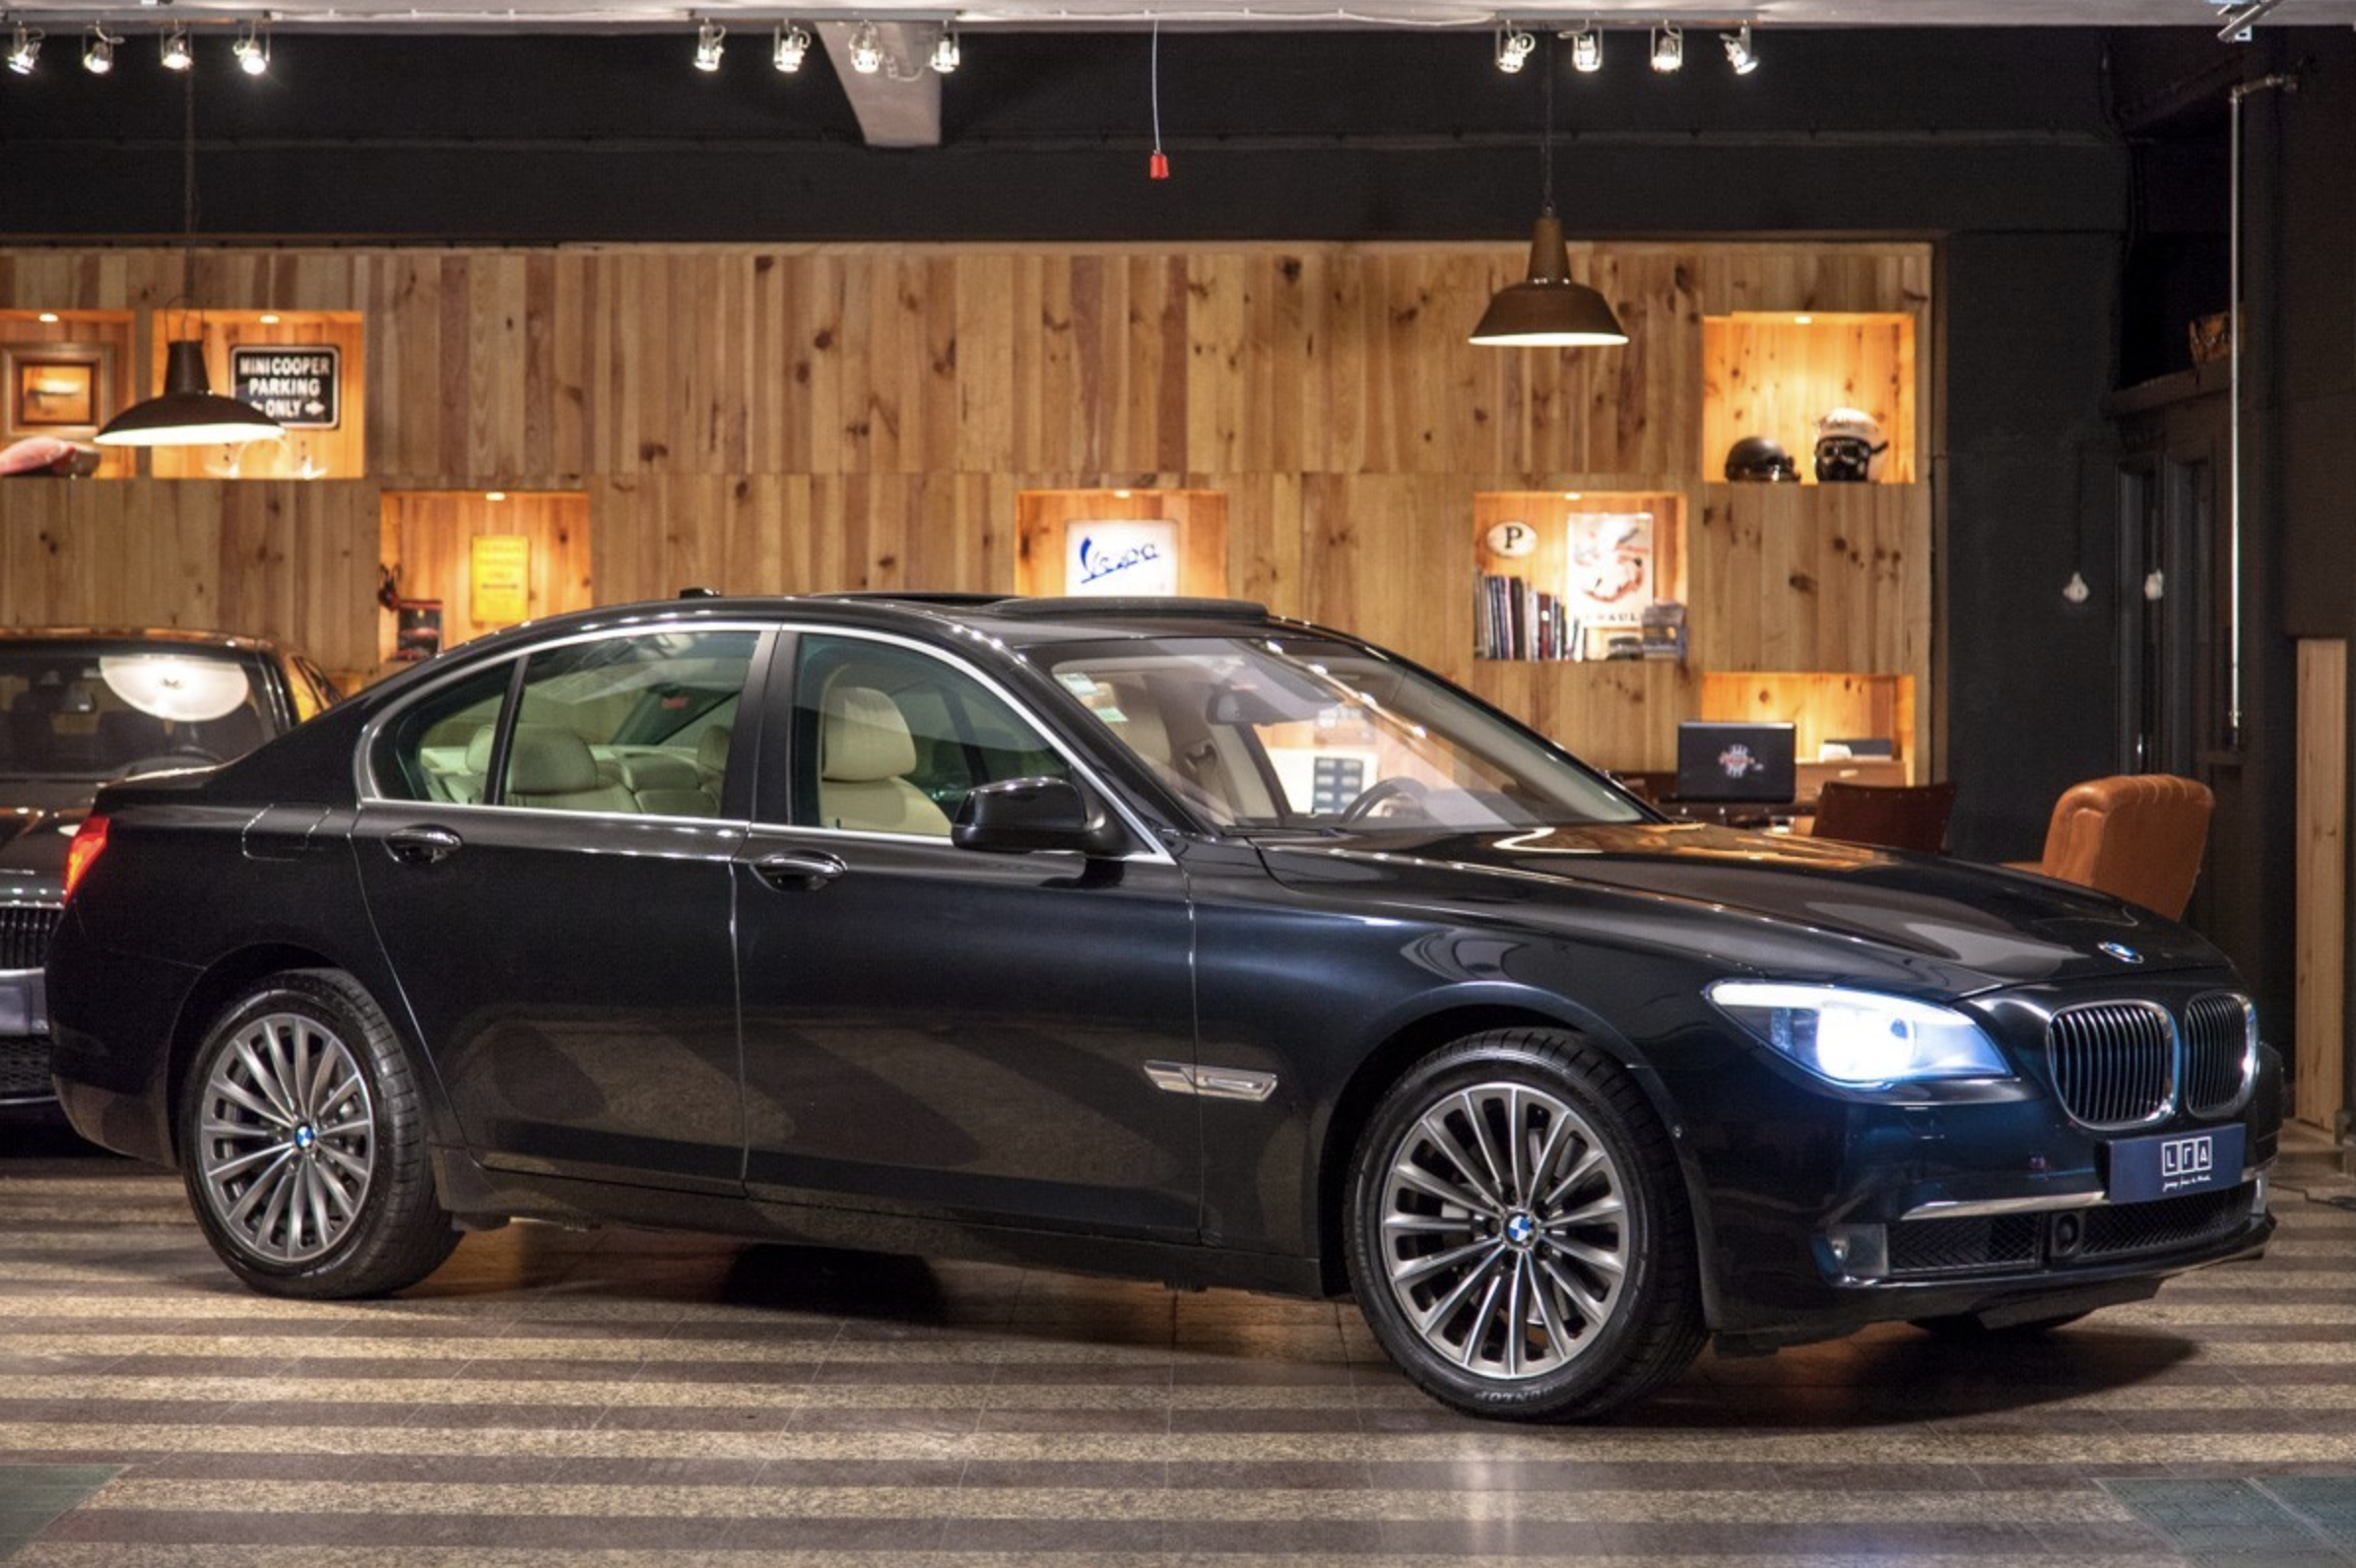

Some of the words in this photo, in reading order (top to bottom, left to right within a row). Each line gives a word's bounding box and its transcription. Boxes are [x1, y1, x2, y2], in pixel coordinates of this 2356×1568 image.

[239, 357, 271, 375] MINI
[271, 357, 330, 376] COOPER
[248, 377, 321, 397] PARKING
[265, 399, 301, 418] ONLY
[1504, 525, 1523, 550] P
[1080, 537, 1160, 584] Vespa
